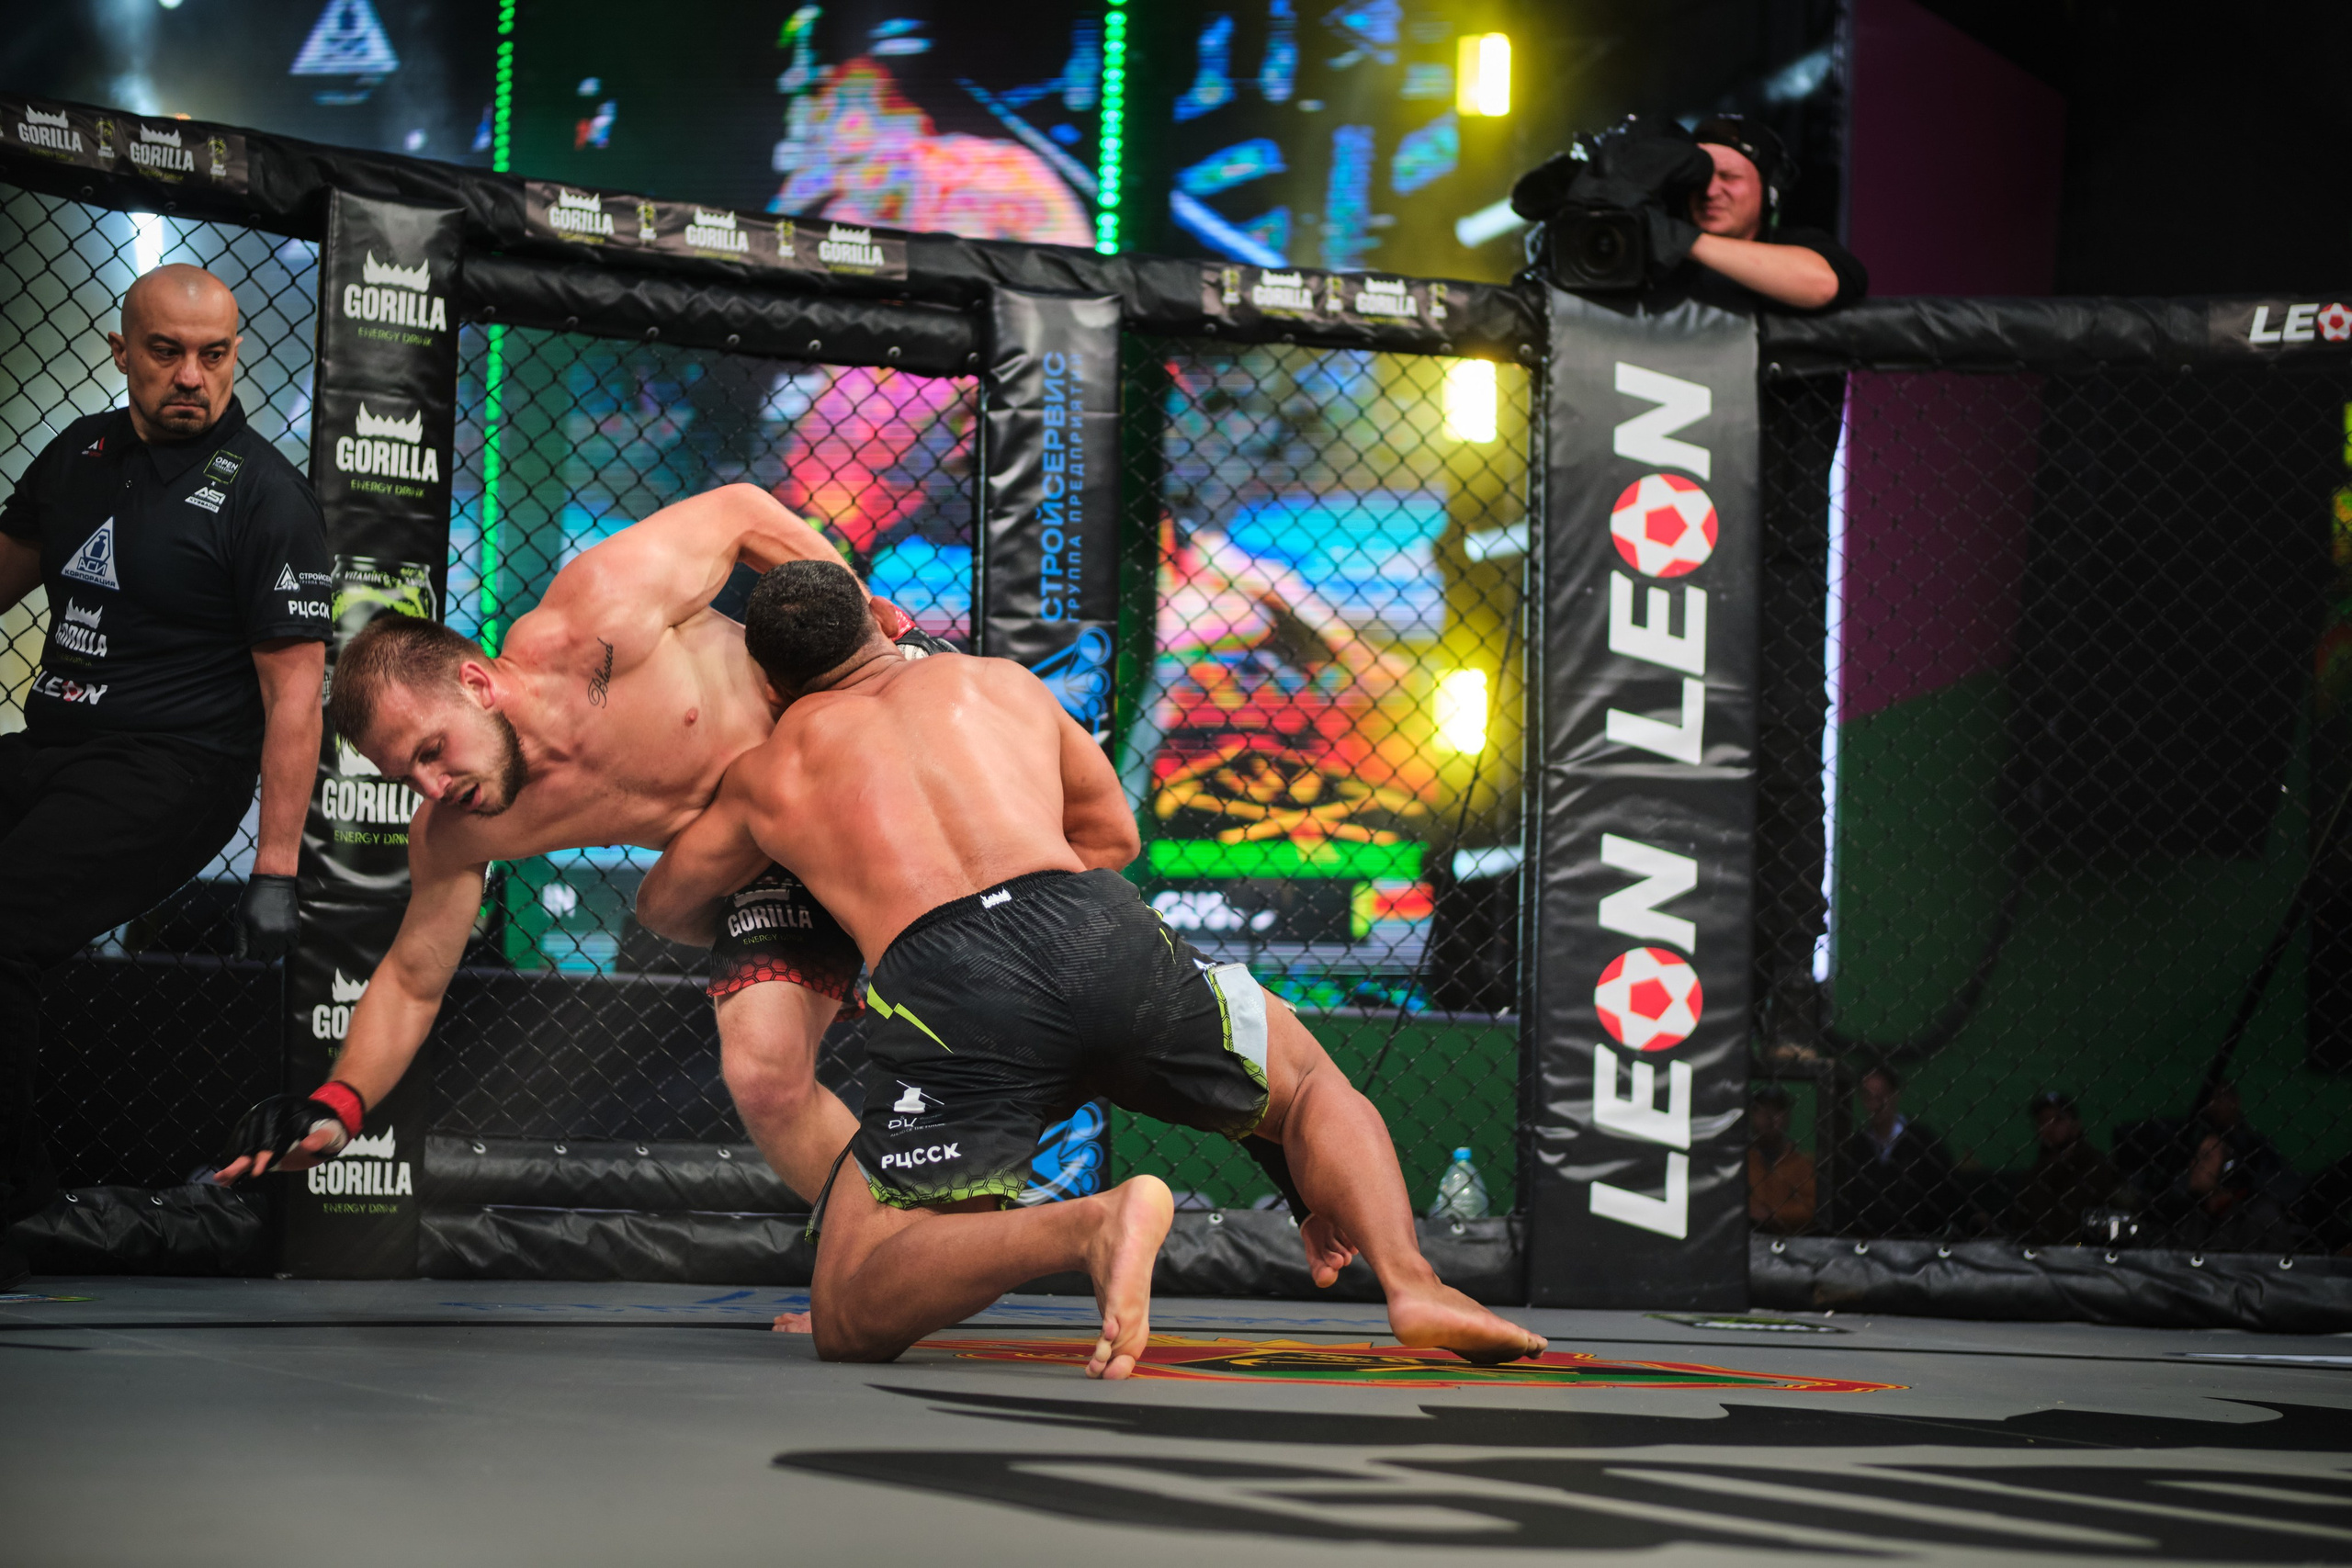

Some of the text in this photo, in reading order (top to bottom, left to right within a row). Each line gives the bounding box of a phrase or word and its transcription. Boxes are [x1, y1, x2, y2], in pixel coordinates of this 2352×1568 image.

[17, 122, 84, 152] GORILLA
[130, 141, 195, 172] GORILLA
[548, 207, 615, 236] GORILLA
[684, 224, 750, 253] GORILLA
[819, 240, 885, 266] GORILLA
[343, 283, 447, 332] GORILLA
[1252, 285, 1313, 310] GORILLA
[1354, 292, 1418, 317] GORILLA
[357, 326, 433, 347] ENERGY DRINK
[216, 456, 239, 472] OPEN
[334, 435, 439, 483] GORILLA
[350, 479, 425, 498] ENERGY DRINK
[1035, 351, 1066, 623] СТРОЙСЕРВИС
[77, 557, 107, 576] АСИ
[1606, 361, 1719, 765] LEON
[64, 569, 116, 588] КОРПОРАЦИЯ
[1068, 535, 1081, 623] ГРУППА
[32, 671, 108, 705] LEON
[334, 829, 409, 846] ENERGY DRIN
[728, 905, 814, 937] GORILLA
[742, 933, 777, 945] ENERGY
[1589, 833, 1703, 1240] LEON
[881, 1142, 962, 1169] РЦССК
[308, 1159, 413, 1196] GORILLA
[322, 1202, 398, 1213] ENERGY DRINK
